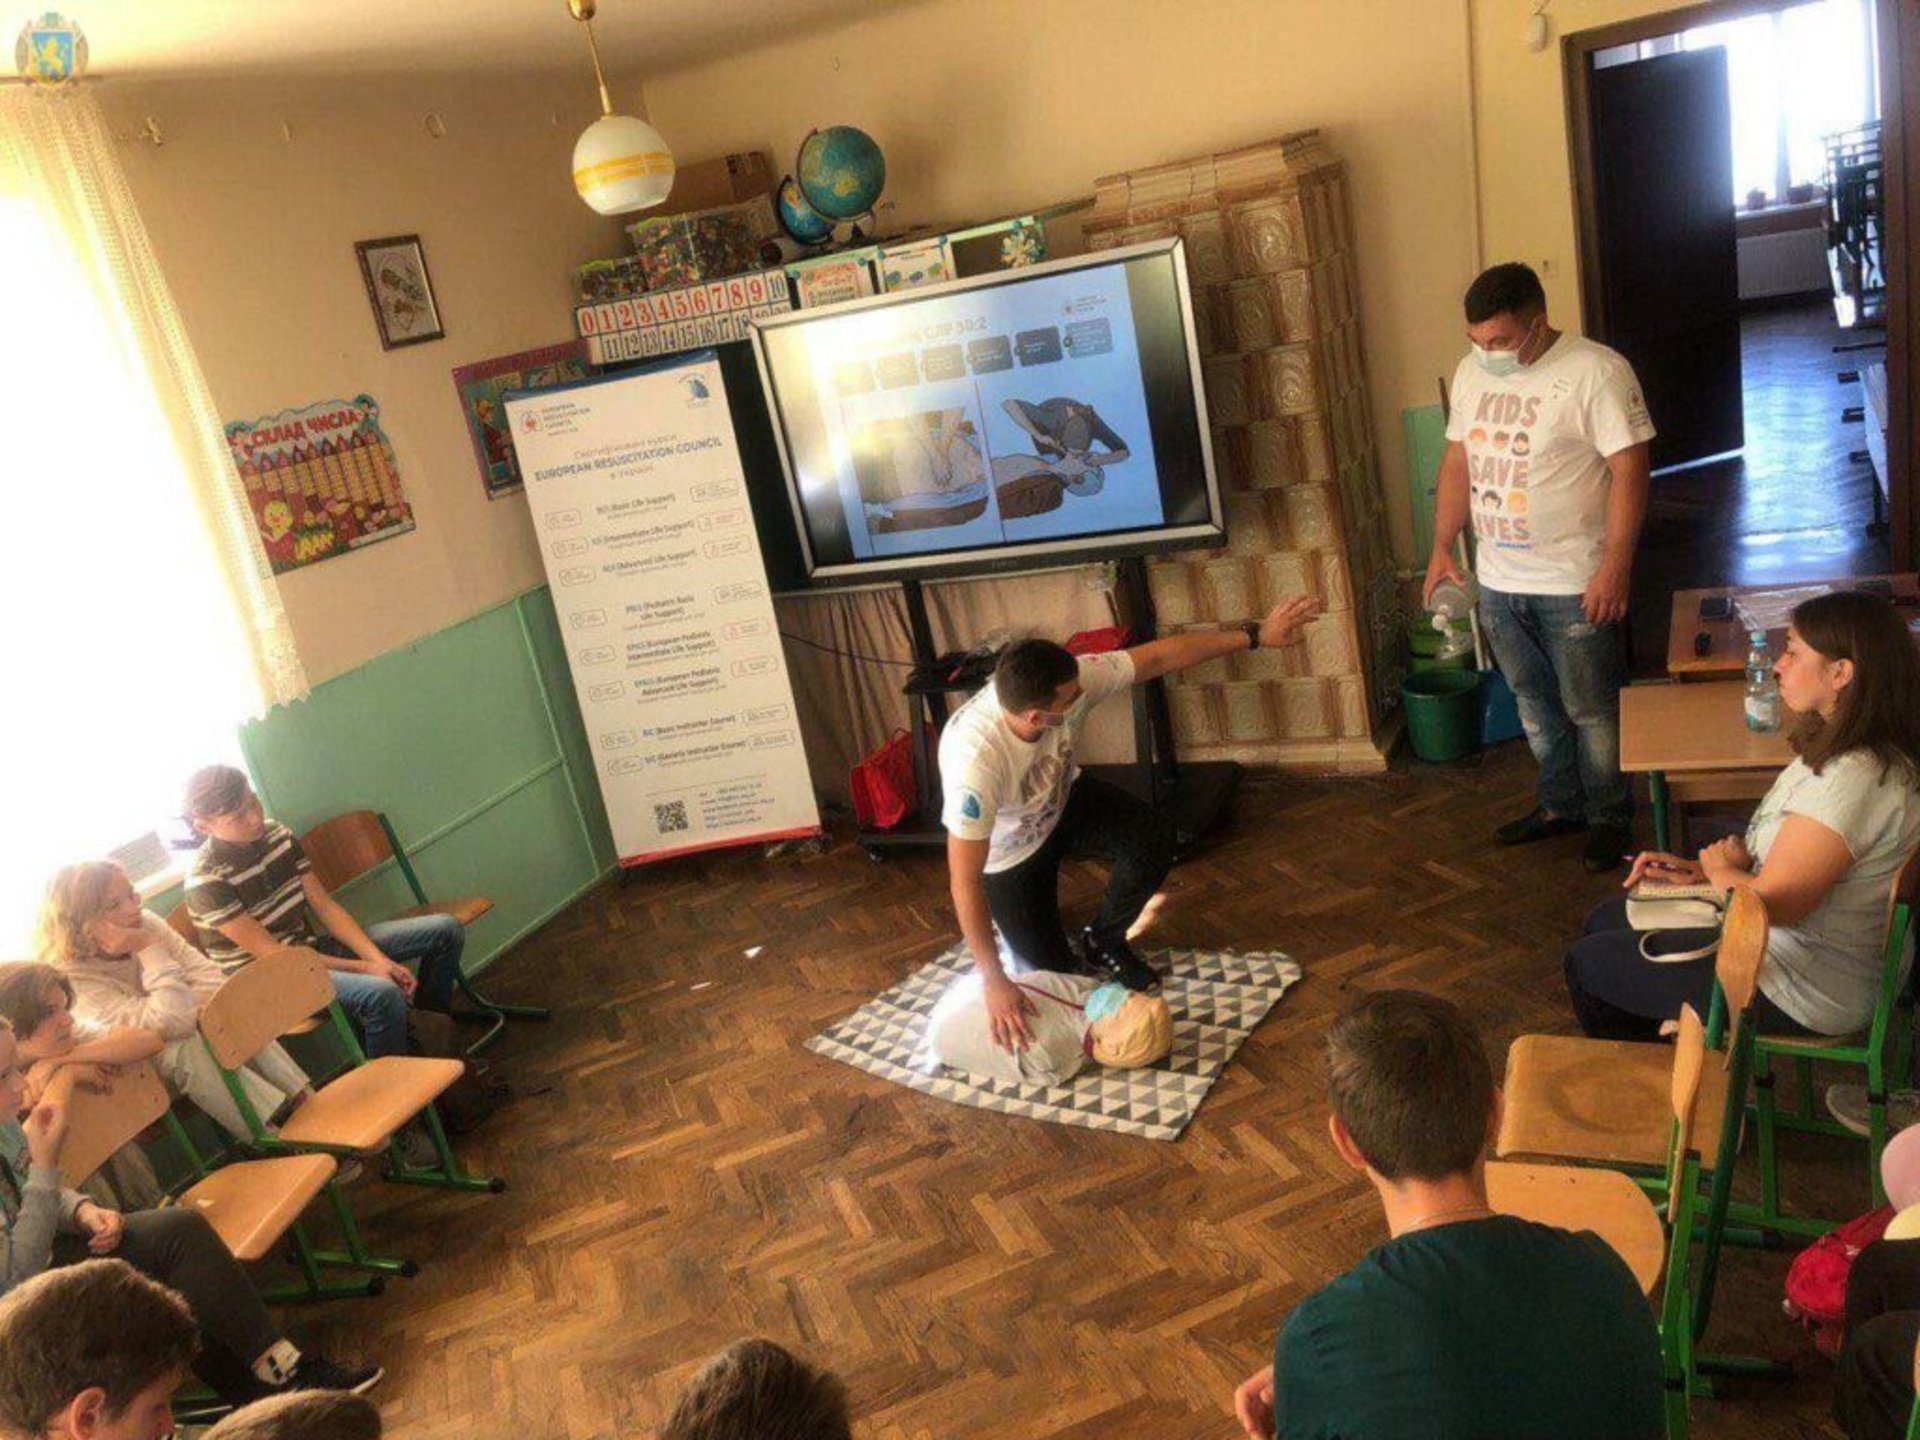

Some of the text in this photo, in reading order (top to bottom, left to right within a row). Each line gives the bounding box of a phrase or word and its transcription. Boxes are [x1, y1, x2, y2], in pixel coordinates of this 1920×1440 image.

[581, 309, 595, 336] 0
[600, 308, 613, 332] 1
[618, 304, 634, 327] 2
[638, 302, 652, 325] 3
[656, 298, 671, 321] 4
[674, 295, 689, 317] 5
[693, 291, 707, 314] 6
[711, 286, 725, 310] 7
[731, 282, 744, 306] 8
[749, 279, 763, 302] 9
[768, 276, 786, 299] 10
[605, 337, 621, 360] 11
[624, 334, 641, 357] 12
[642, 330, 659, 353] 13
[660, 326, 677, 350] 14
[679, 323, 697, 347] 15
[698, 320, 716, 344] 16
[717, 317, 732, 341] 17
[251, 409, 359, 448] СКЛАД ЧИСЛА
[1474, 391, 1543, 427] KIDS
[534, 436, 724, 482] EUROPEAN RESUSCITATION COUNCIL
[1470, 454, 1529, 489] SAVE
[1474, 512, 1531, 541] IVES
